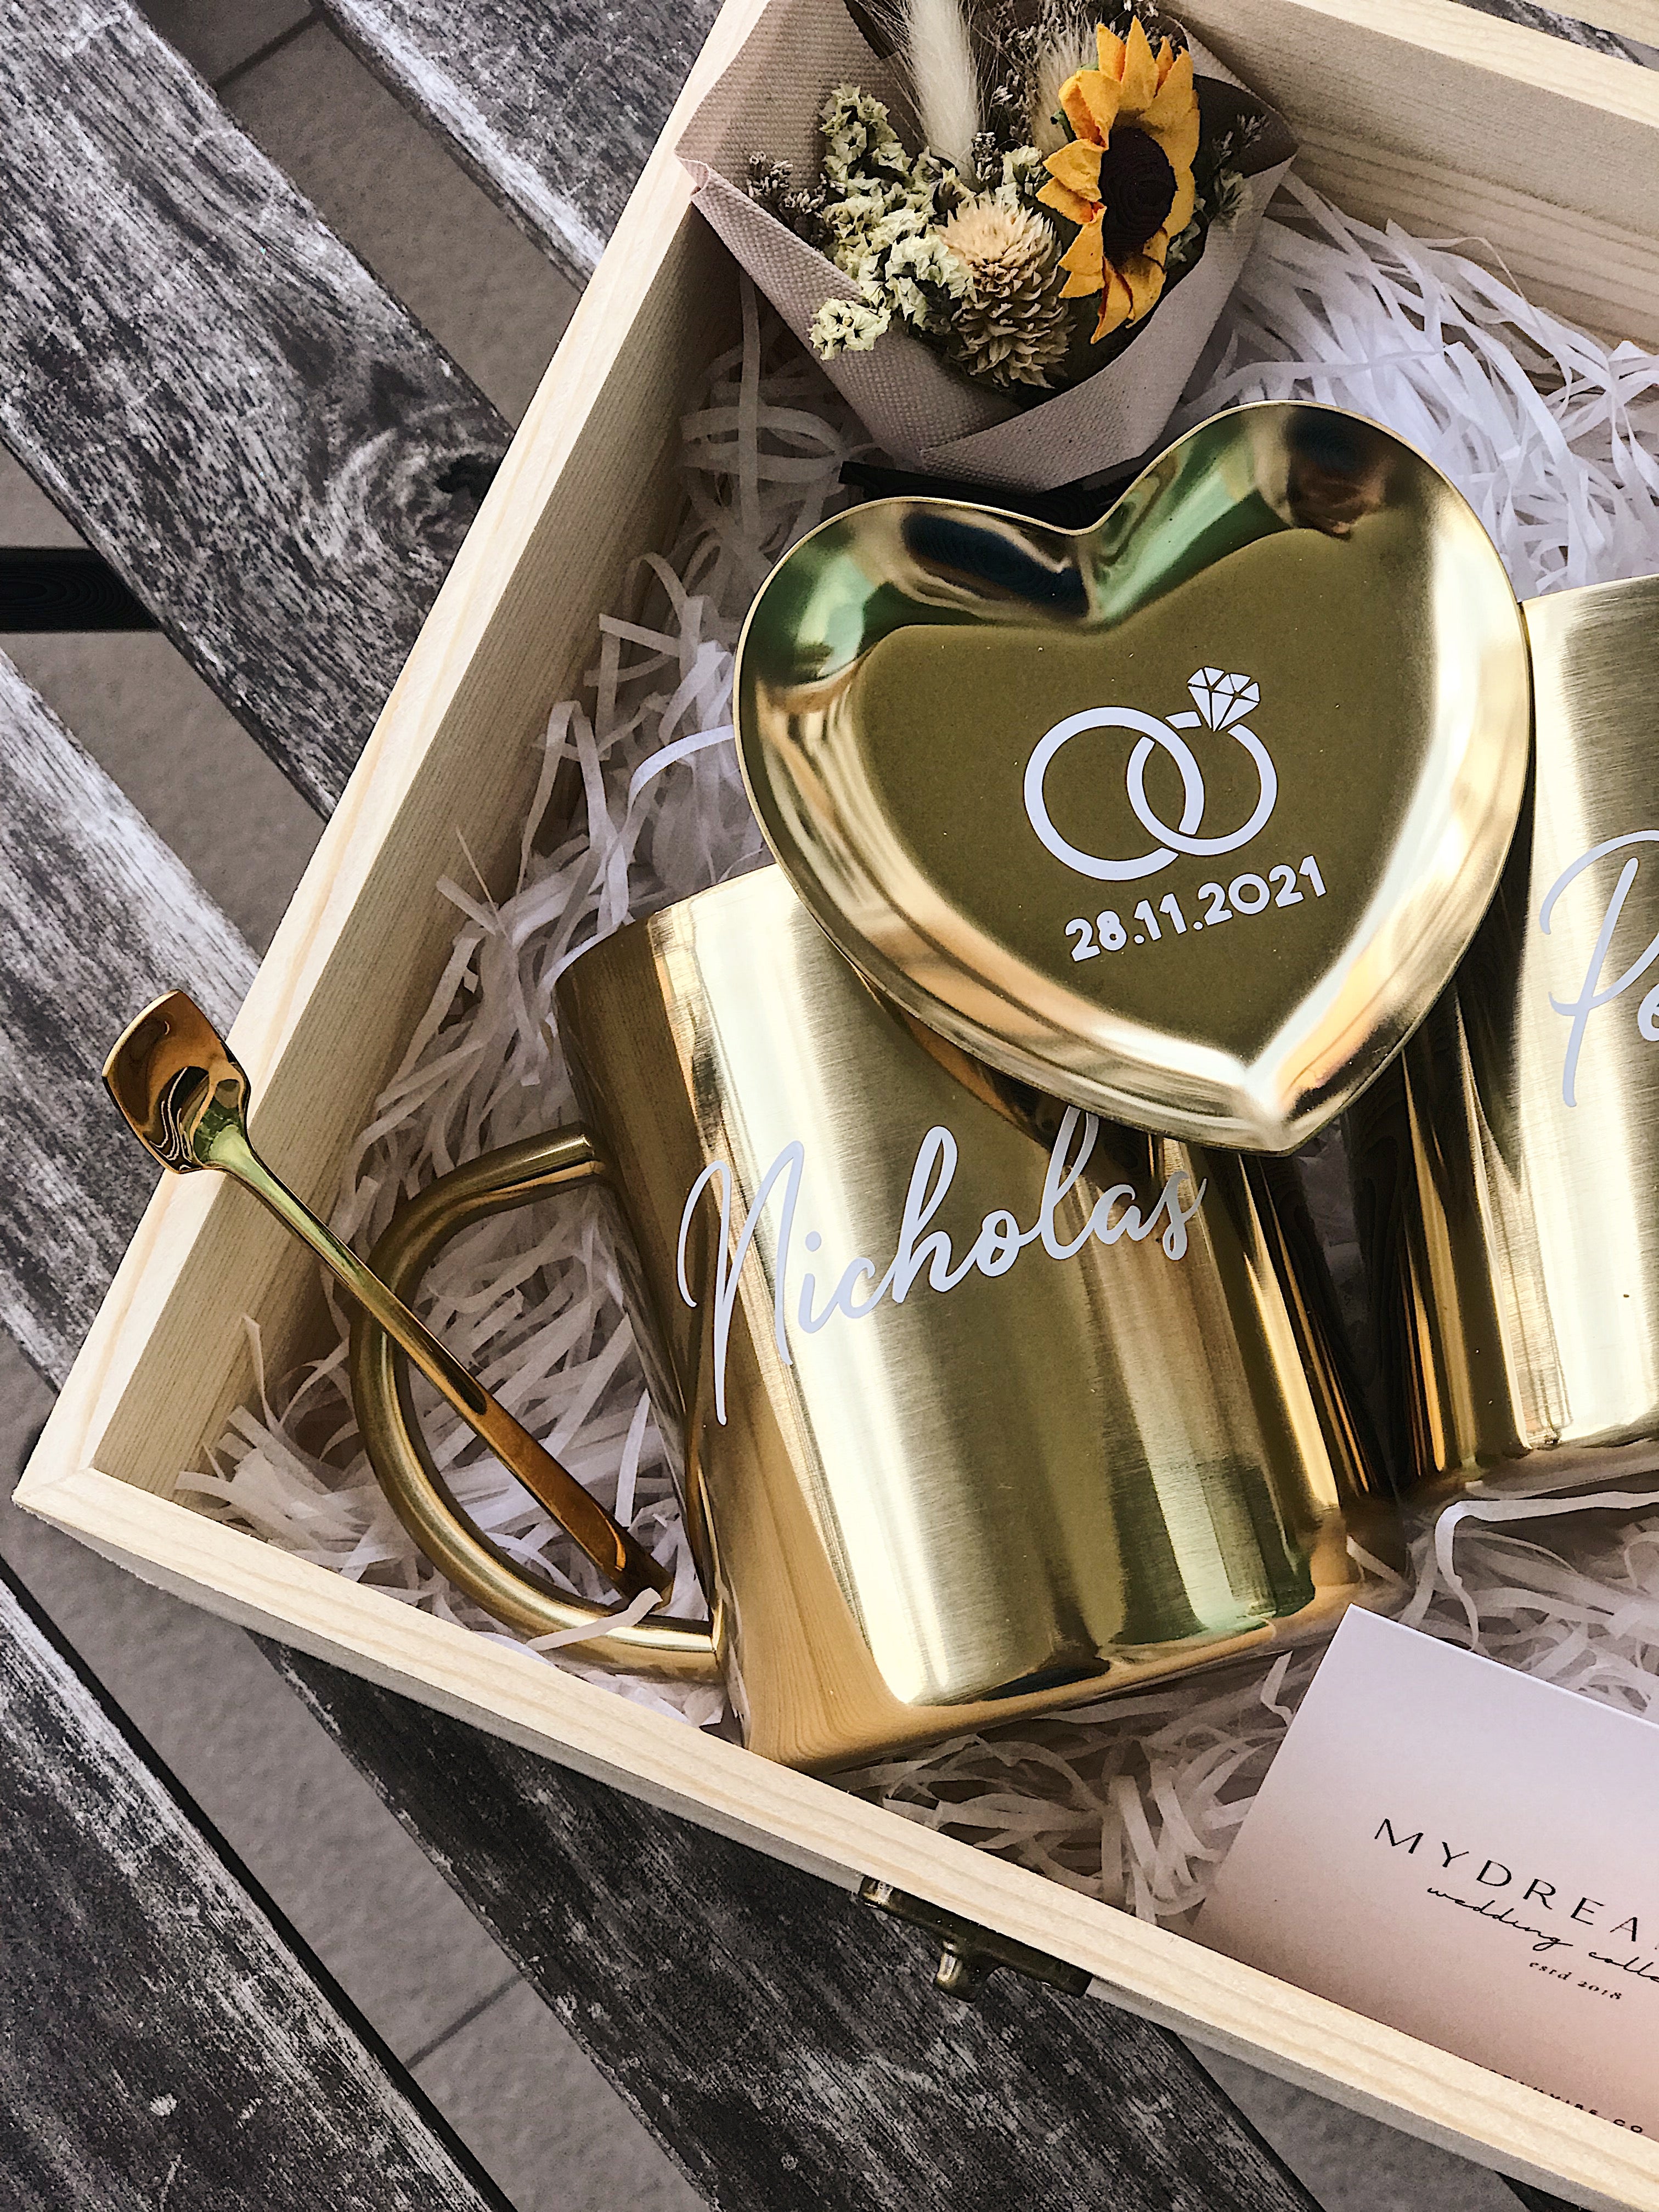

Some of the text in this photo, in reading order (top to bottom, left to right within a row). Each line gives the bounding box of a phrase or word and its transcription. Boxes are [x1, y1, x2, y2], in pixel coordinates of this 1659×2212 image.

[1065, 855, 1327, 962] 28.11.2021
[678, 1105, 1207, 1425] Nicholas
[1374, 1818, 1659, 1950] MYDREA
[1427, 1887, 1573, 1951] wedding
[1577, 1980, 1622, 2000] 2018
